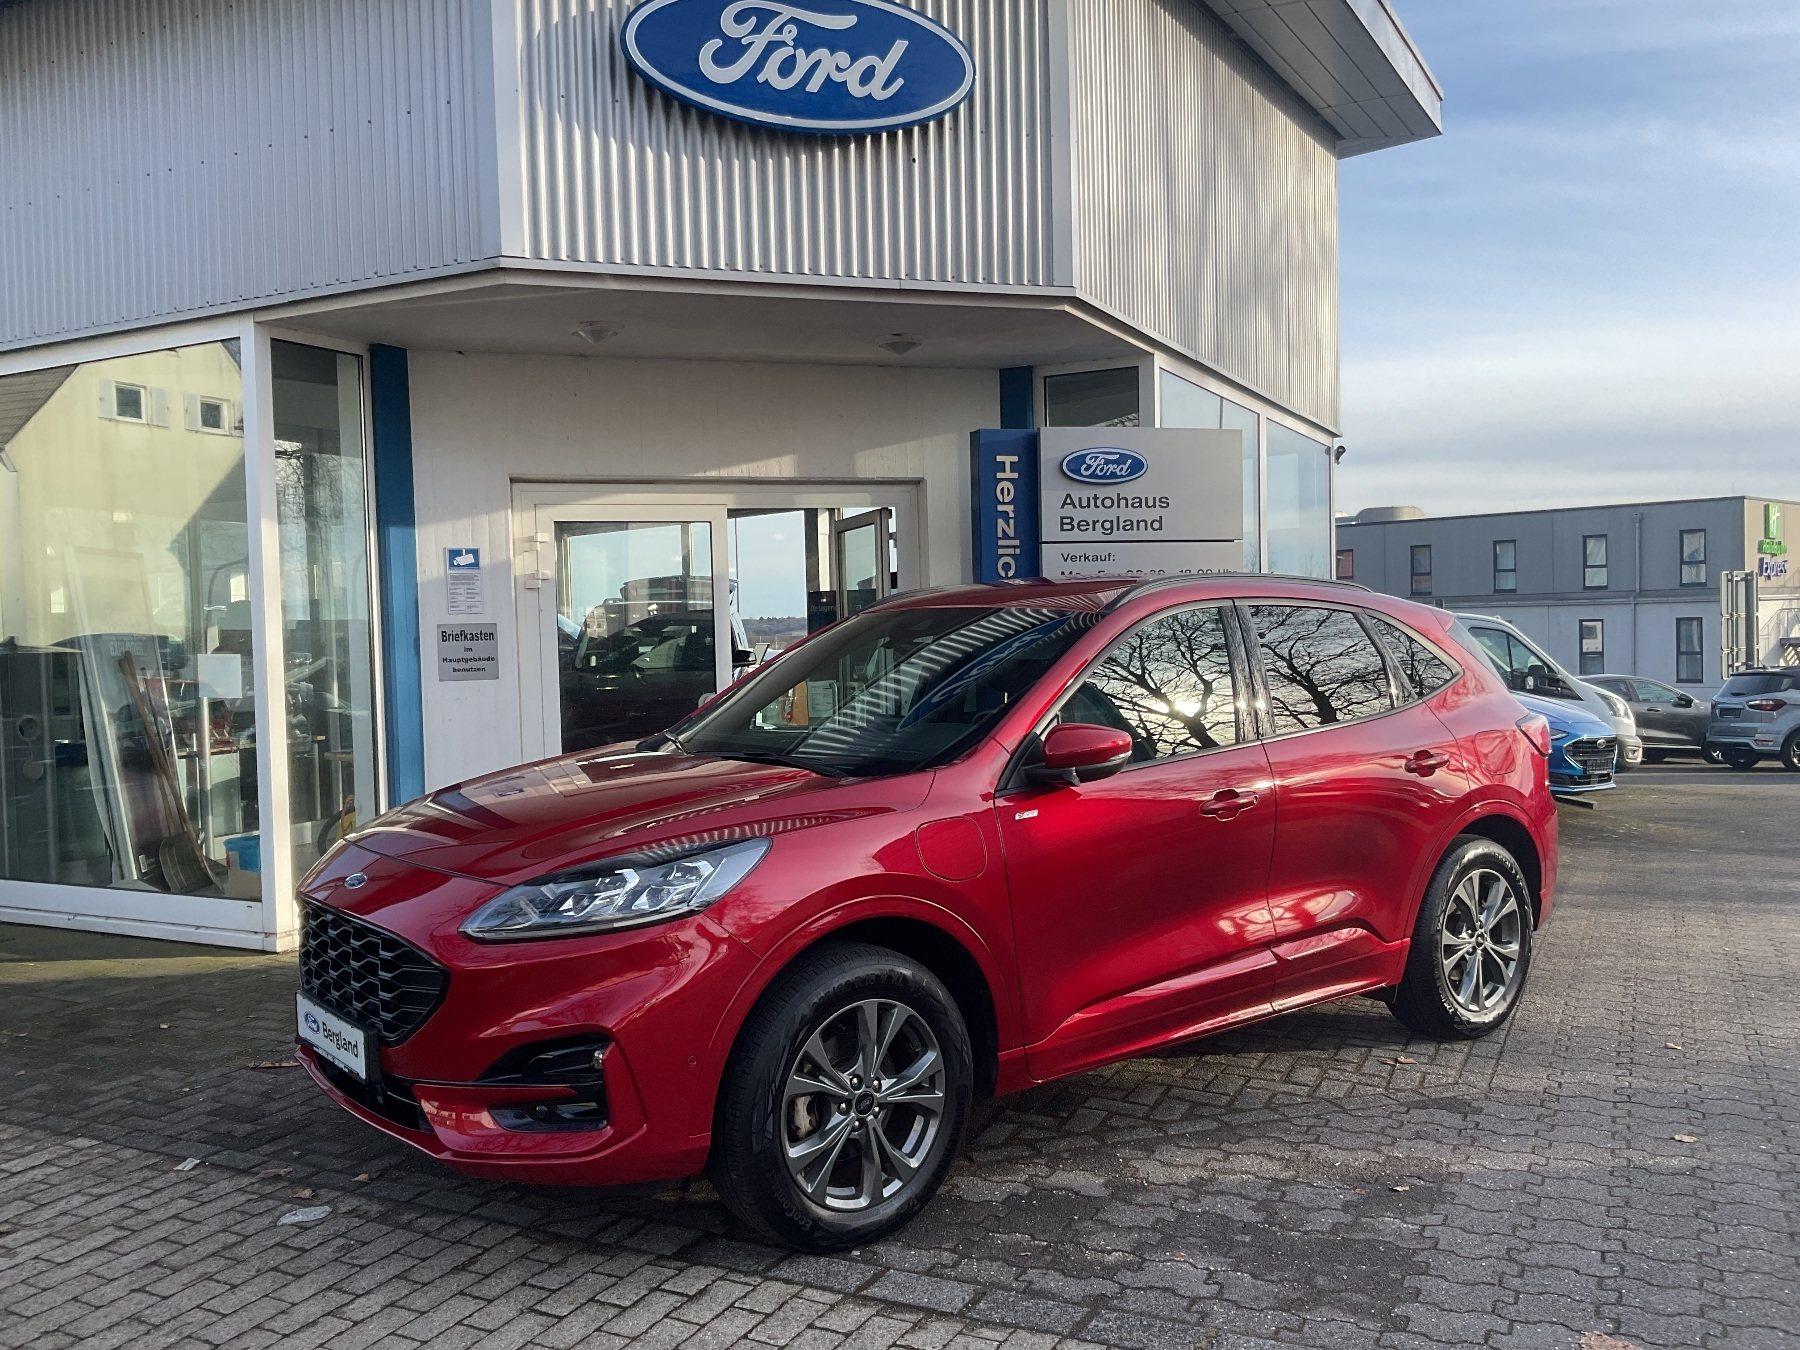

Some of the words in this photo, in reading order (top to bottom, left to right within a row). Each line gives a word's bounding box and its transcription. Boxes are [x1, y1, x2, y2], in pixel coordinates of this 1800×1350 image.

[699, 0, 908, 100] Ford
[1080, 453, 1132, 476] Ford
[1060, 493, 1170, 509] Autohaus
[1060, 515, 1163, 535] Bergland
[1061, 552, 1116, 563] Verkauf:
[441, 630, 495, 643] Briefkasten
[322, 1021, 358, 1058] Bergland
